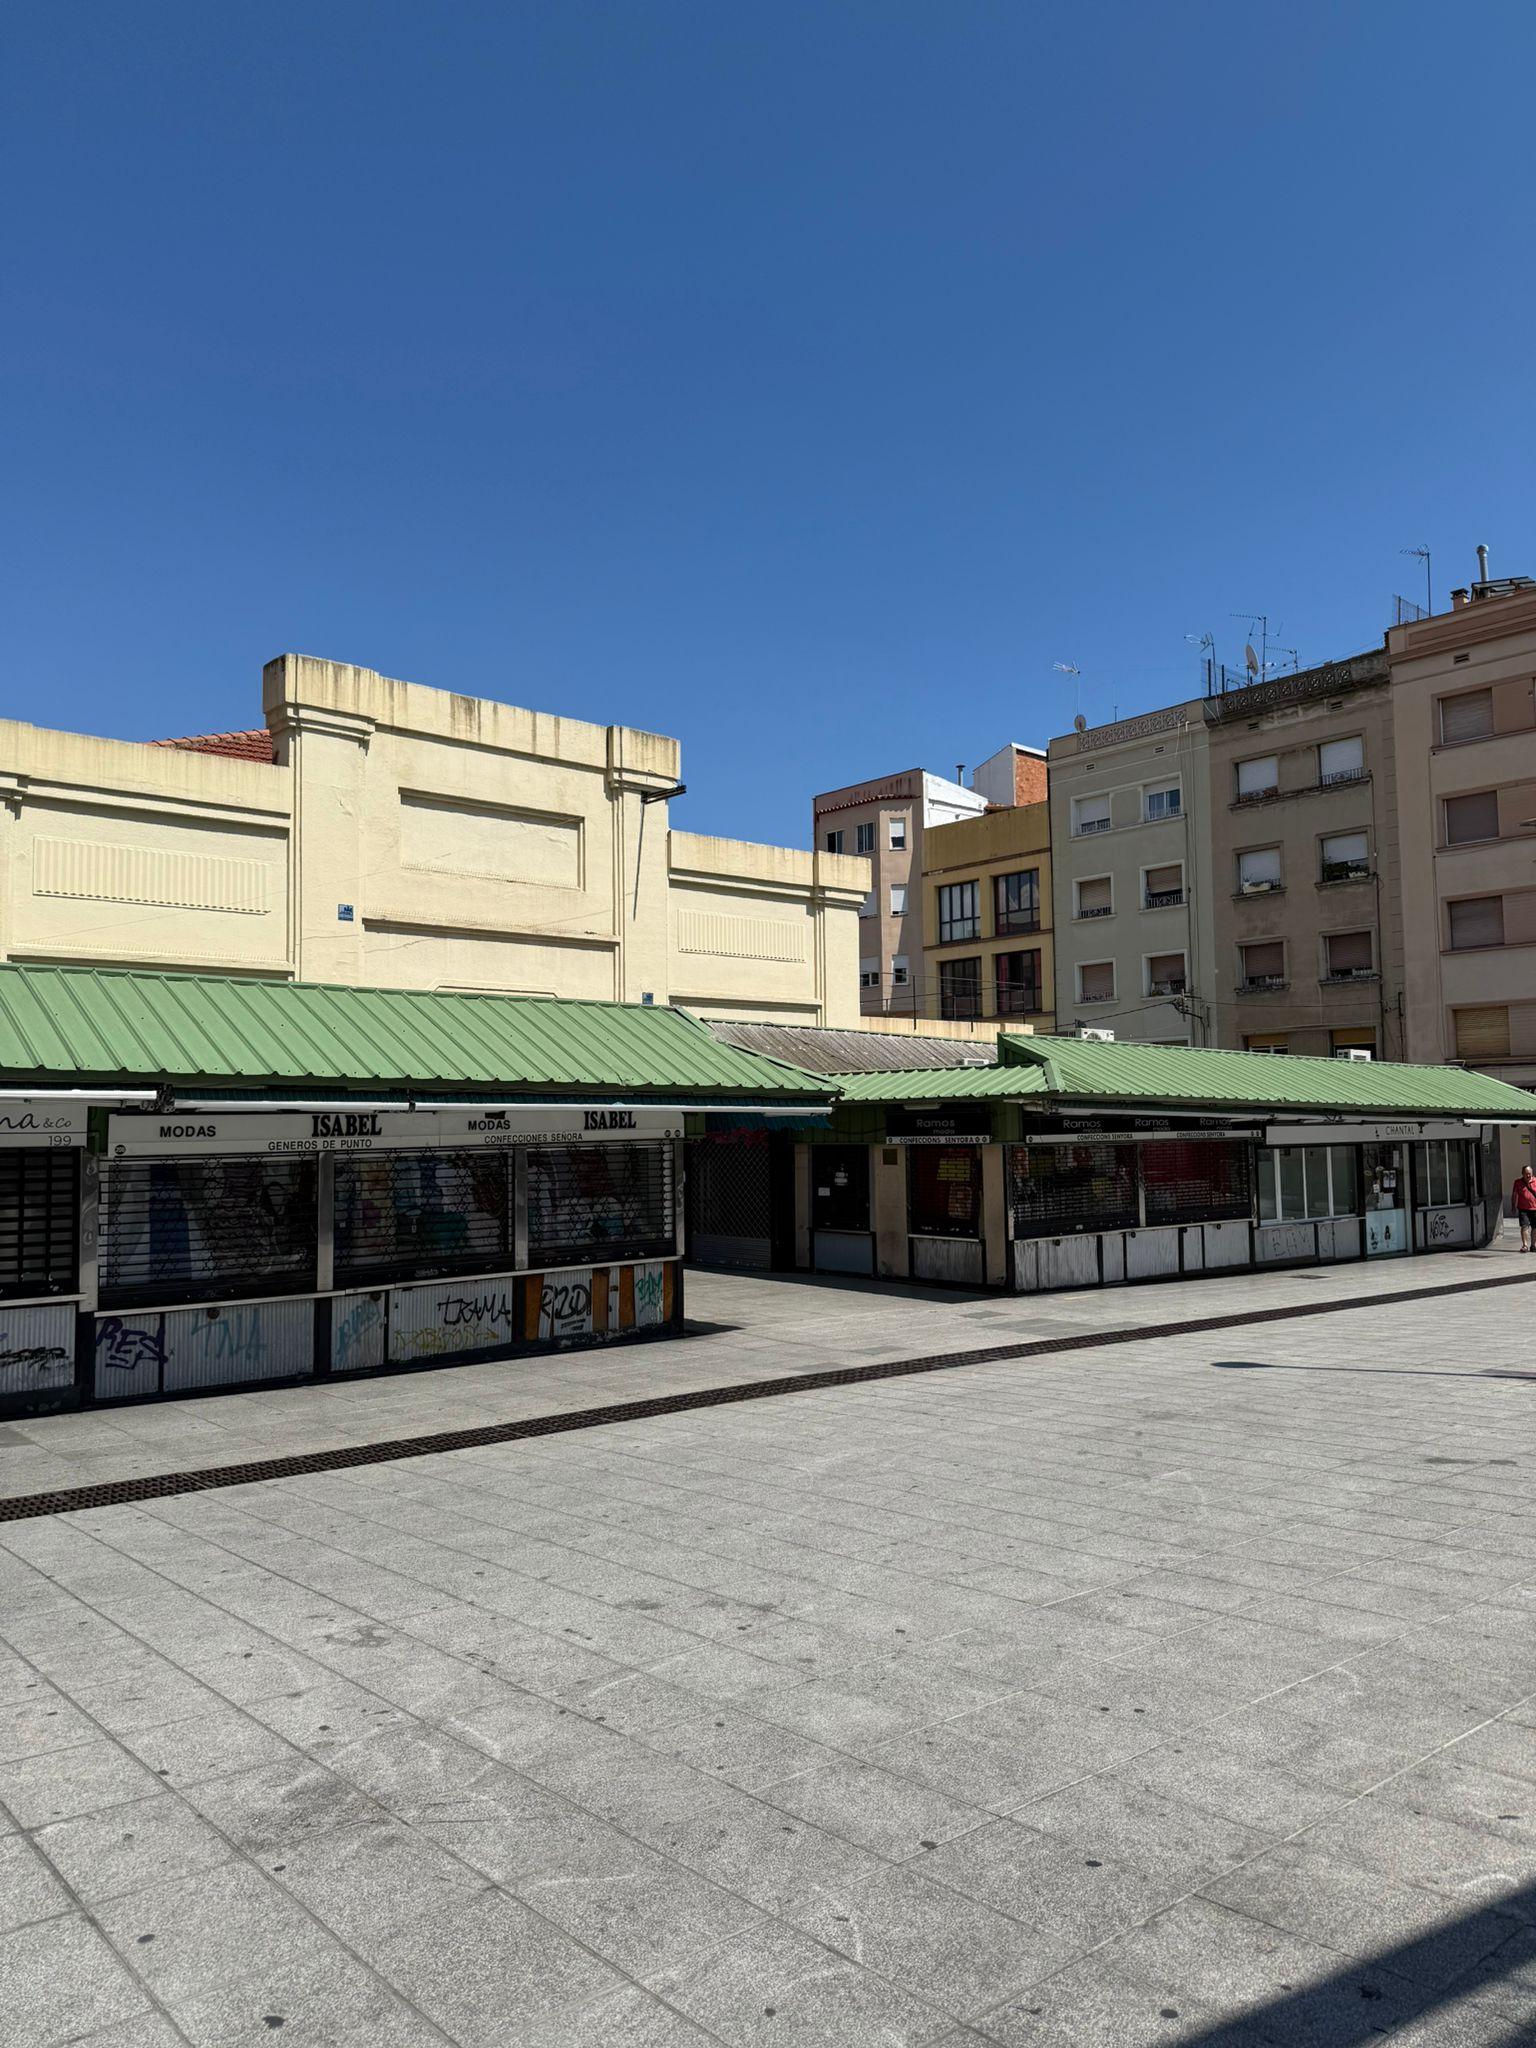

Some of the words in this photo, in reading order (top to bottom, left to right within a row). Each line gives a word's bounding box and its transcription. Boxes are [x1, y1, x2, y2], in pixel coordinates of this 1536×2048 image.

[312, 1113, 382, 1137] ISABEL
[468, 1119, 511, 1131] MODAS
[584, 1111, 636, 1130] ISABEL
[916, 1119, 956, 1128] Ramos
[1063, 1119, 1101, 1129] Ramos
[1134, 1118, 1169, 1127] Ramos
[160, 1125, 217, 1138] MODAS
[1386, 1125, 1415, 1136] CHANTAL
[49, 1135, 72, 1147] 199
[484, 1133, 548, 1144] CONFECCIONES
[551, 1131, 583, 1142] SEÑORA
[268, 1140, 318, 1151] GENEROS
[322, 1140, 335, 1149] DE
[341, 1138, 372, 1149] PUNTO
